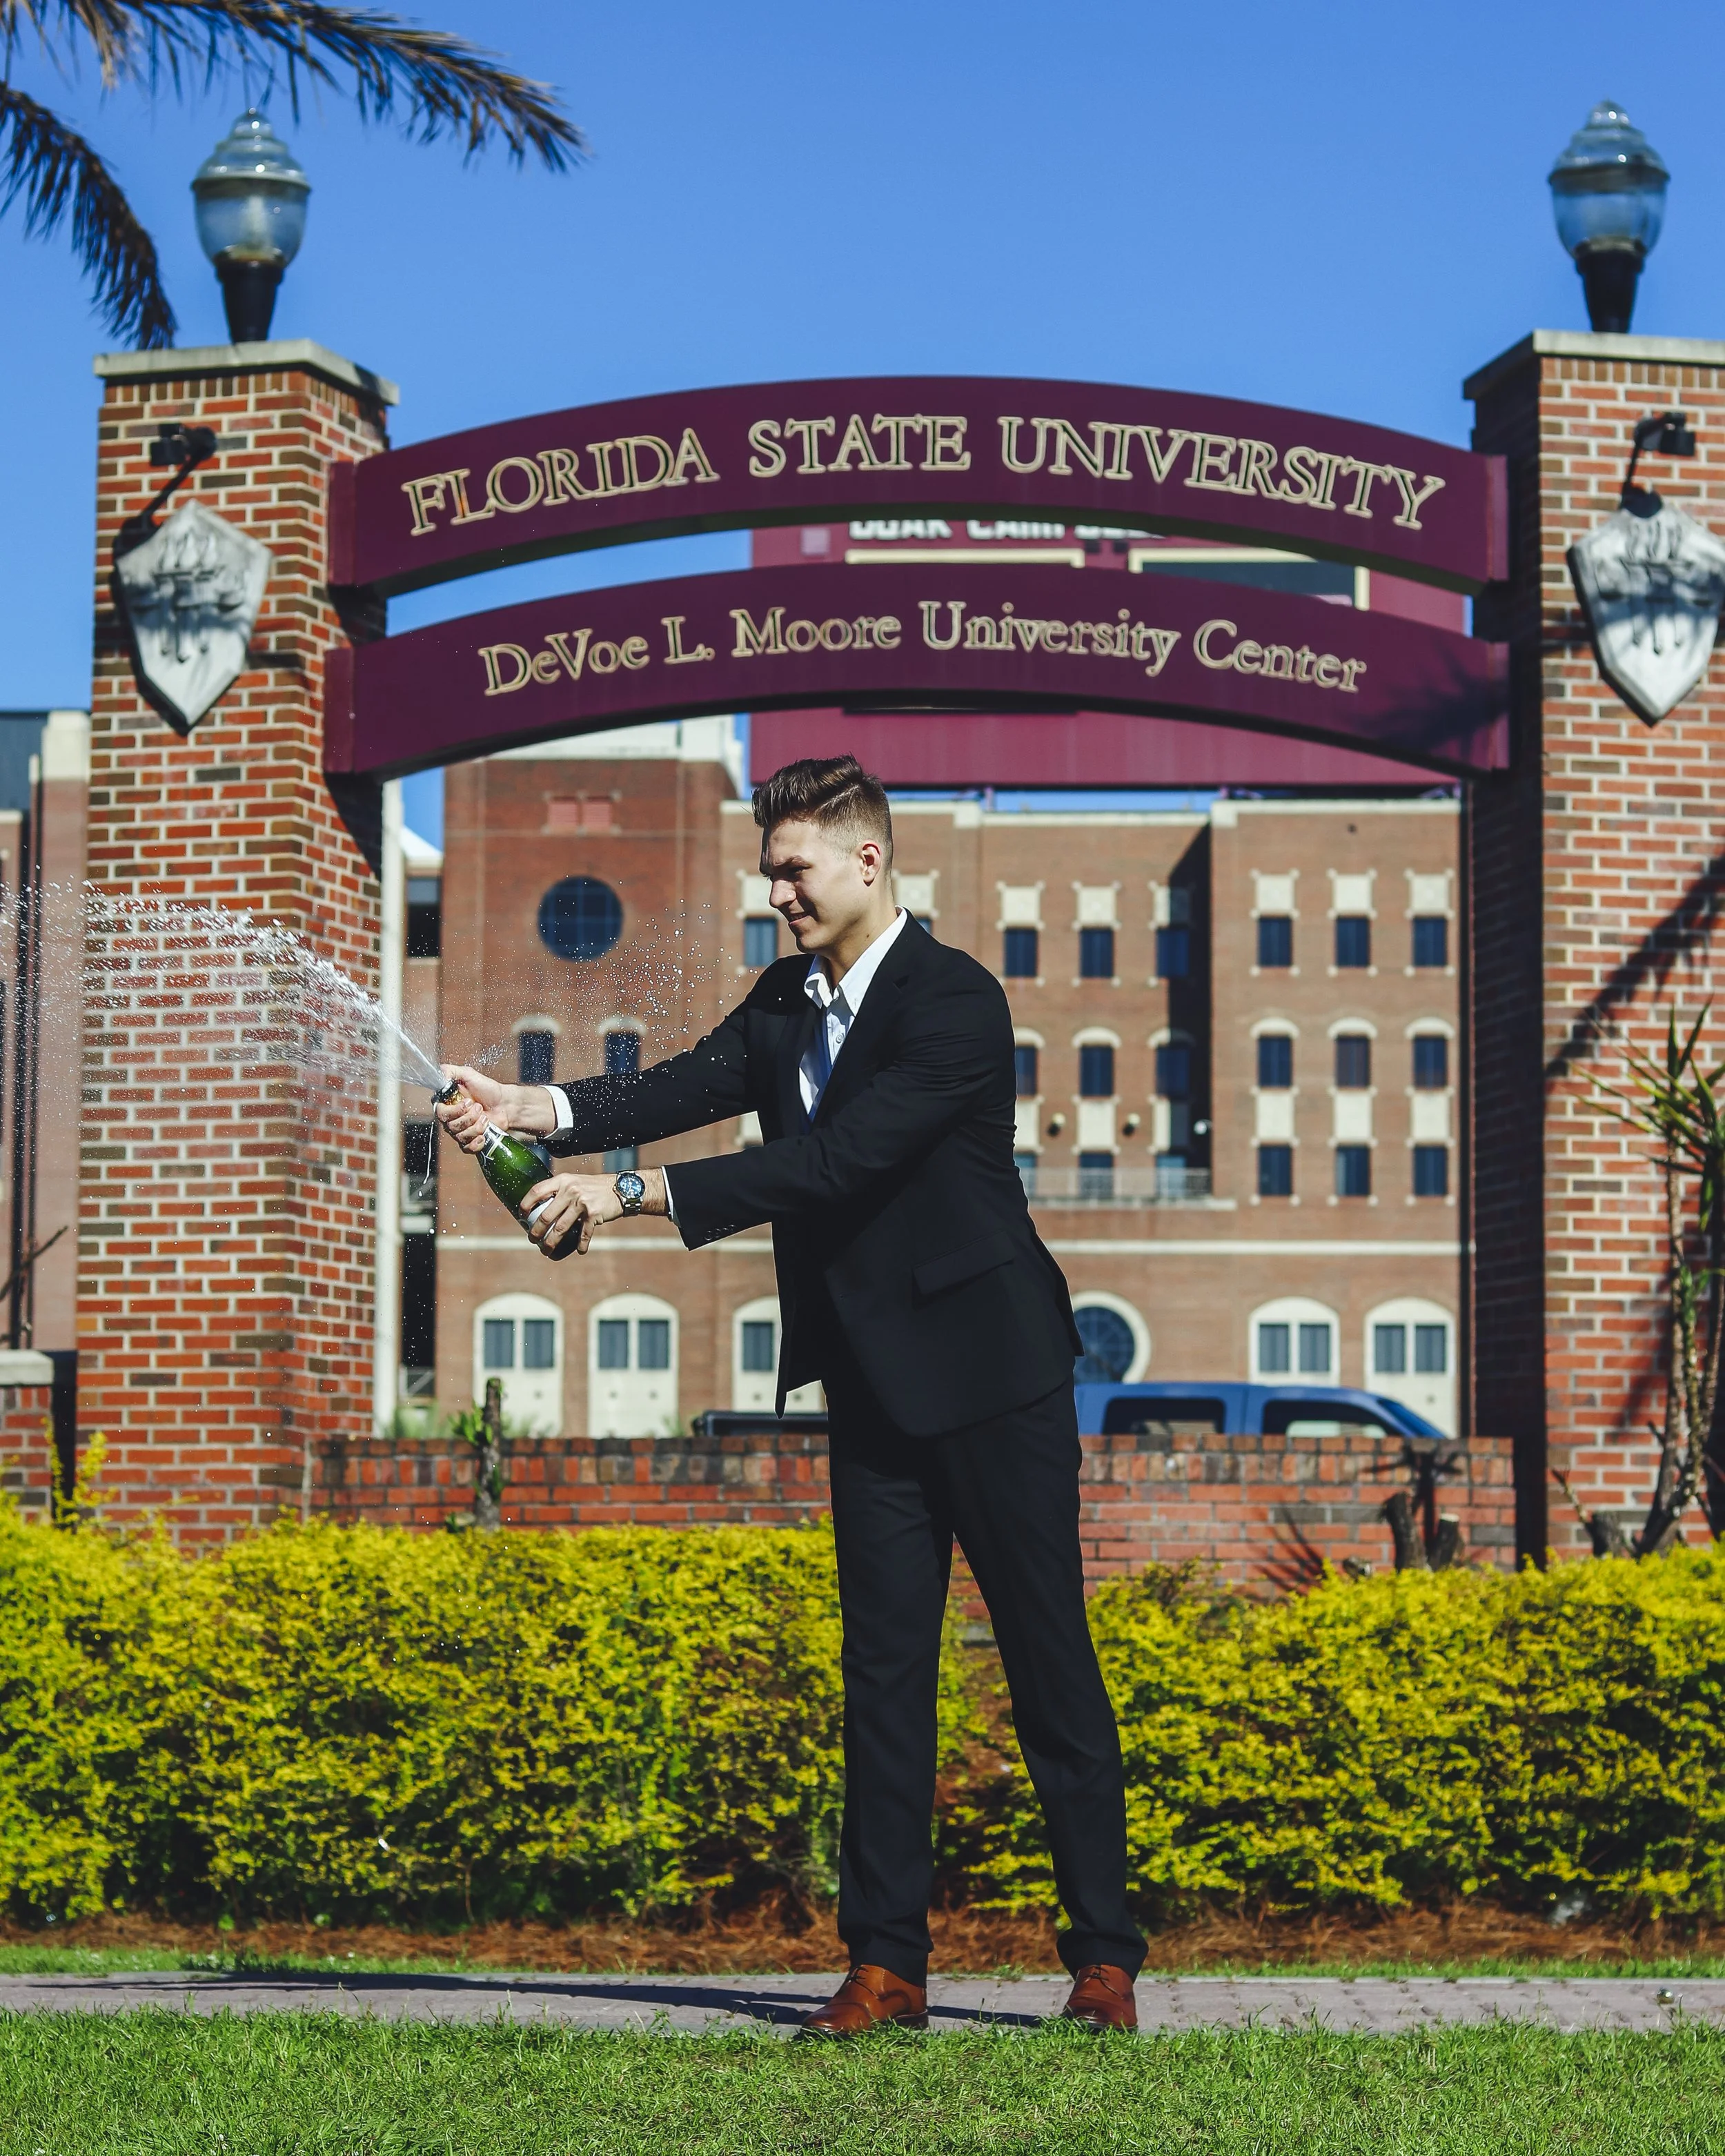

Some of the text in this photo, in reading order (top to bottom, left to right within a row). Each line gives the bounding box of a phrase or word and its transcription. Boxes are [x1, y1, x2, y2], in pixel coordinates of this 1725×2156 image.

[401, 413, 1446, 536] FLORIDA STATE UNIVERSITY
[478, 601, 1367, 696] DeVoe L. Moore University Center
